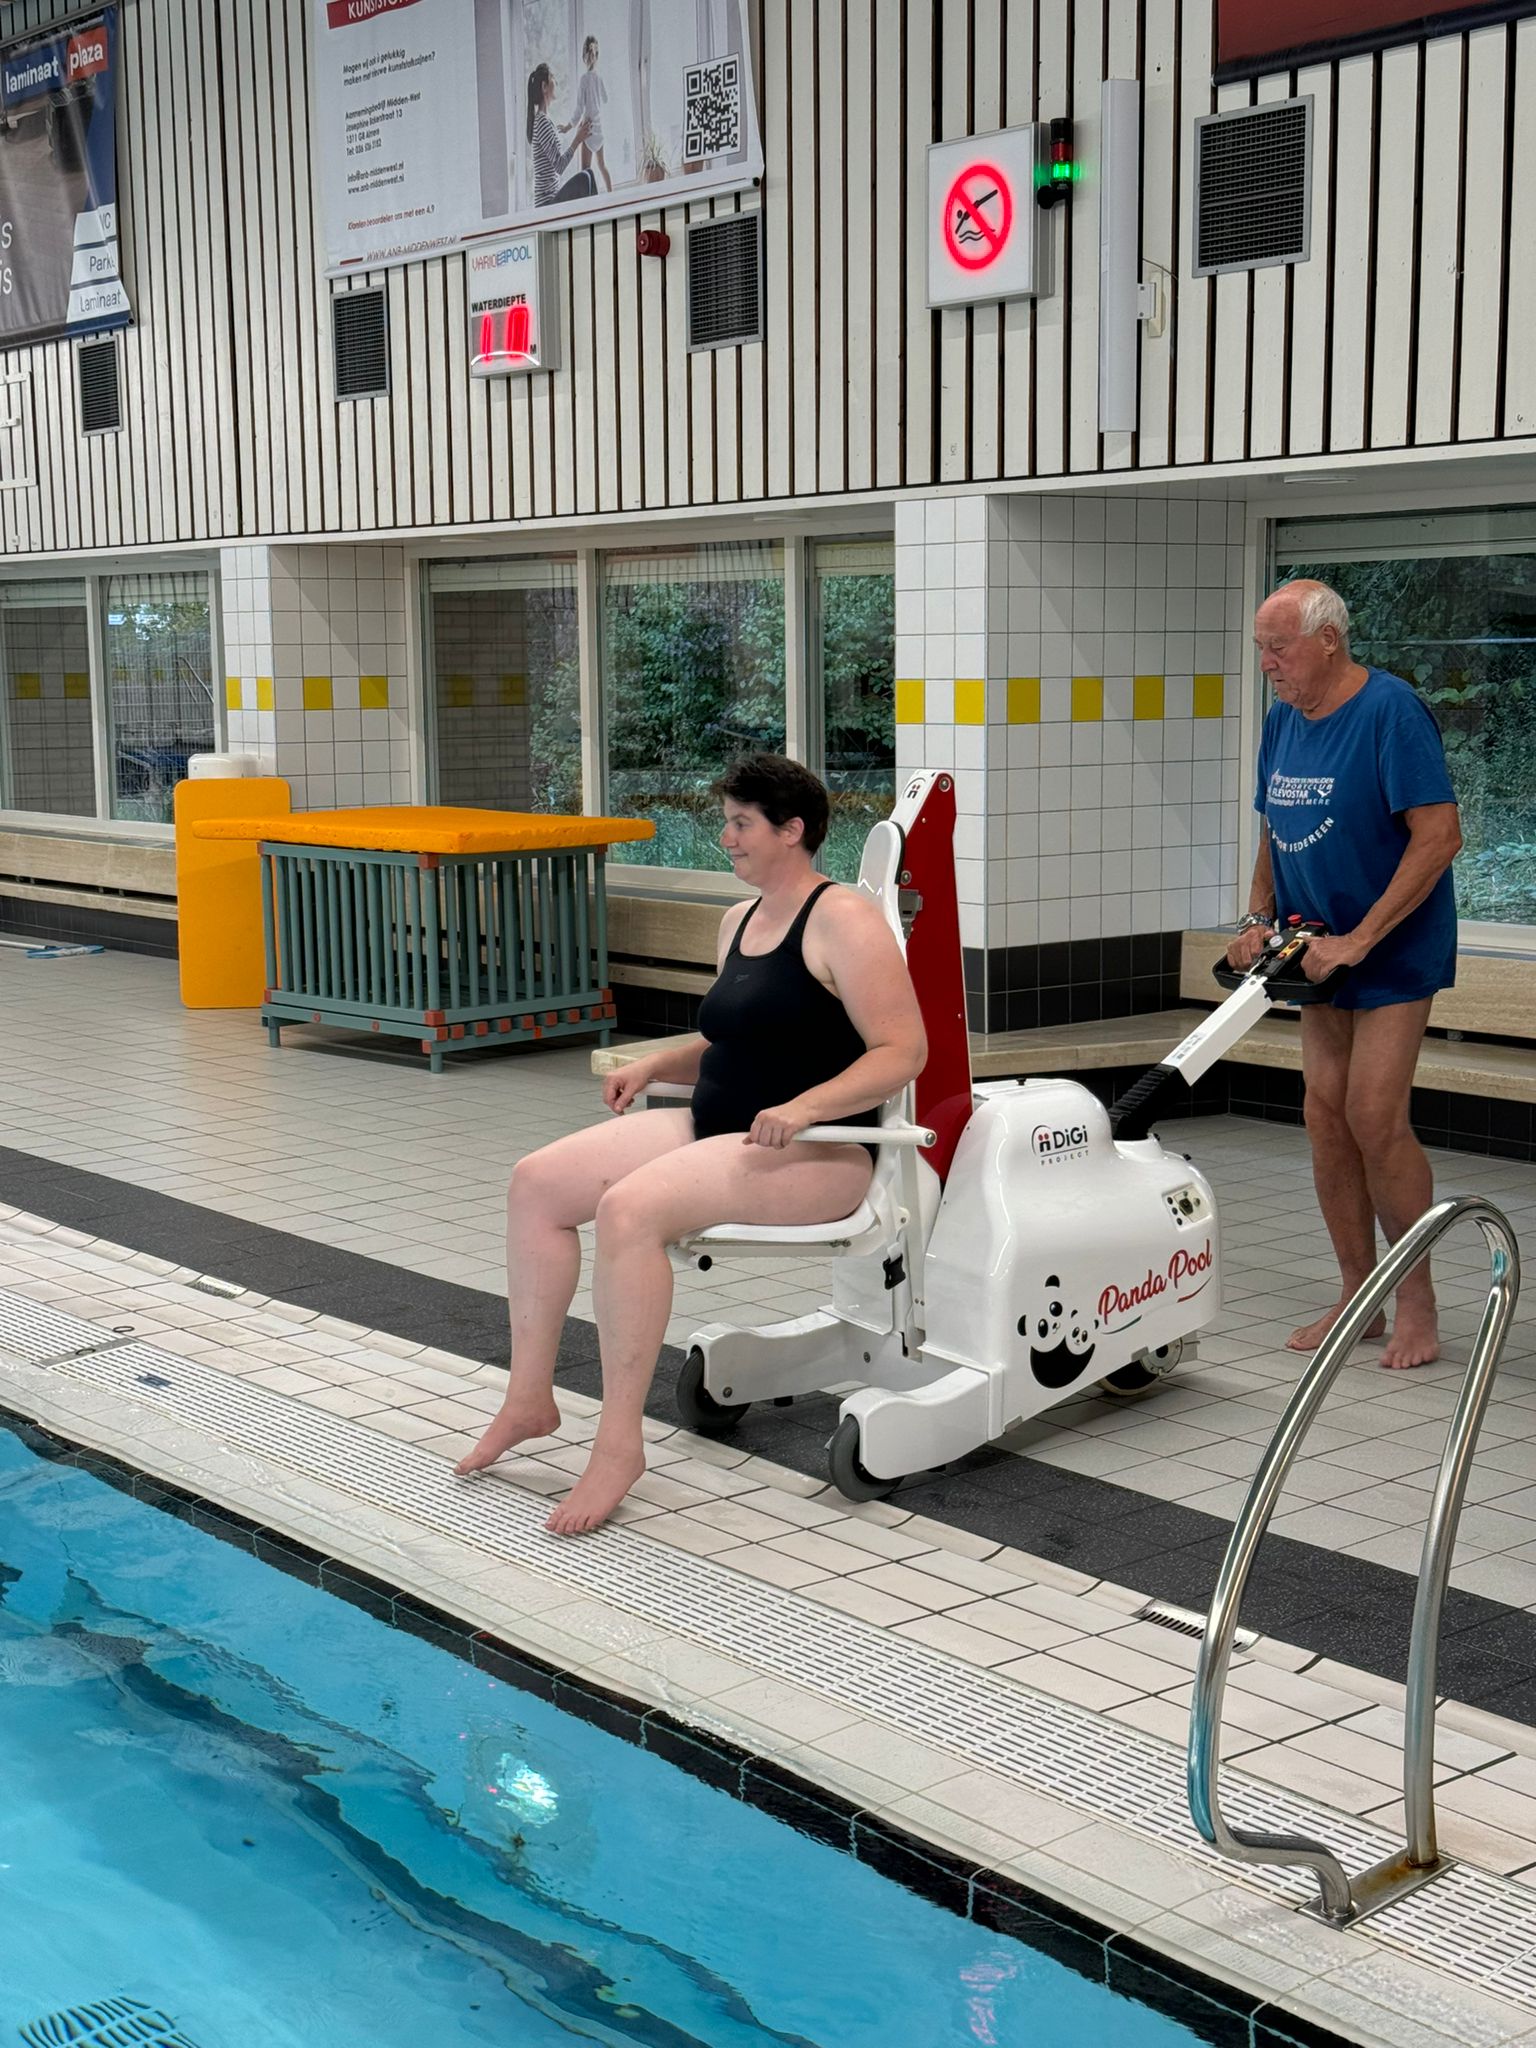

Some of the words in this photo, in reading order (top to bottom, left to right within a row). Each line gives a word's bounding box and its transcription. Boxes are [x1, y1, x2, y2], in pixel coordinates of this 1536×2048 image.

[5, 55, 60, 94] laminaat
[69, 42, 104, 76] plaza
[342, 62, 362, 74] Mogen
[380, 48, 406, 64] gelukkig
[395, 108, 403, 119] 13
[414, 206, 426, 217] een
[79, 288, 121, 313] Laminaat
[471, 293, 527, 314] WATERDIEPTE
[530, 343, 537, 355] M
[1289, 816, 1335, 853] IEDEREEN
[1040, 1149, 1090, 1166] PROJECT
[1097, 1268, 1168, 1326] Panda
[1167, 1238, 1213, 1290] Pool
